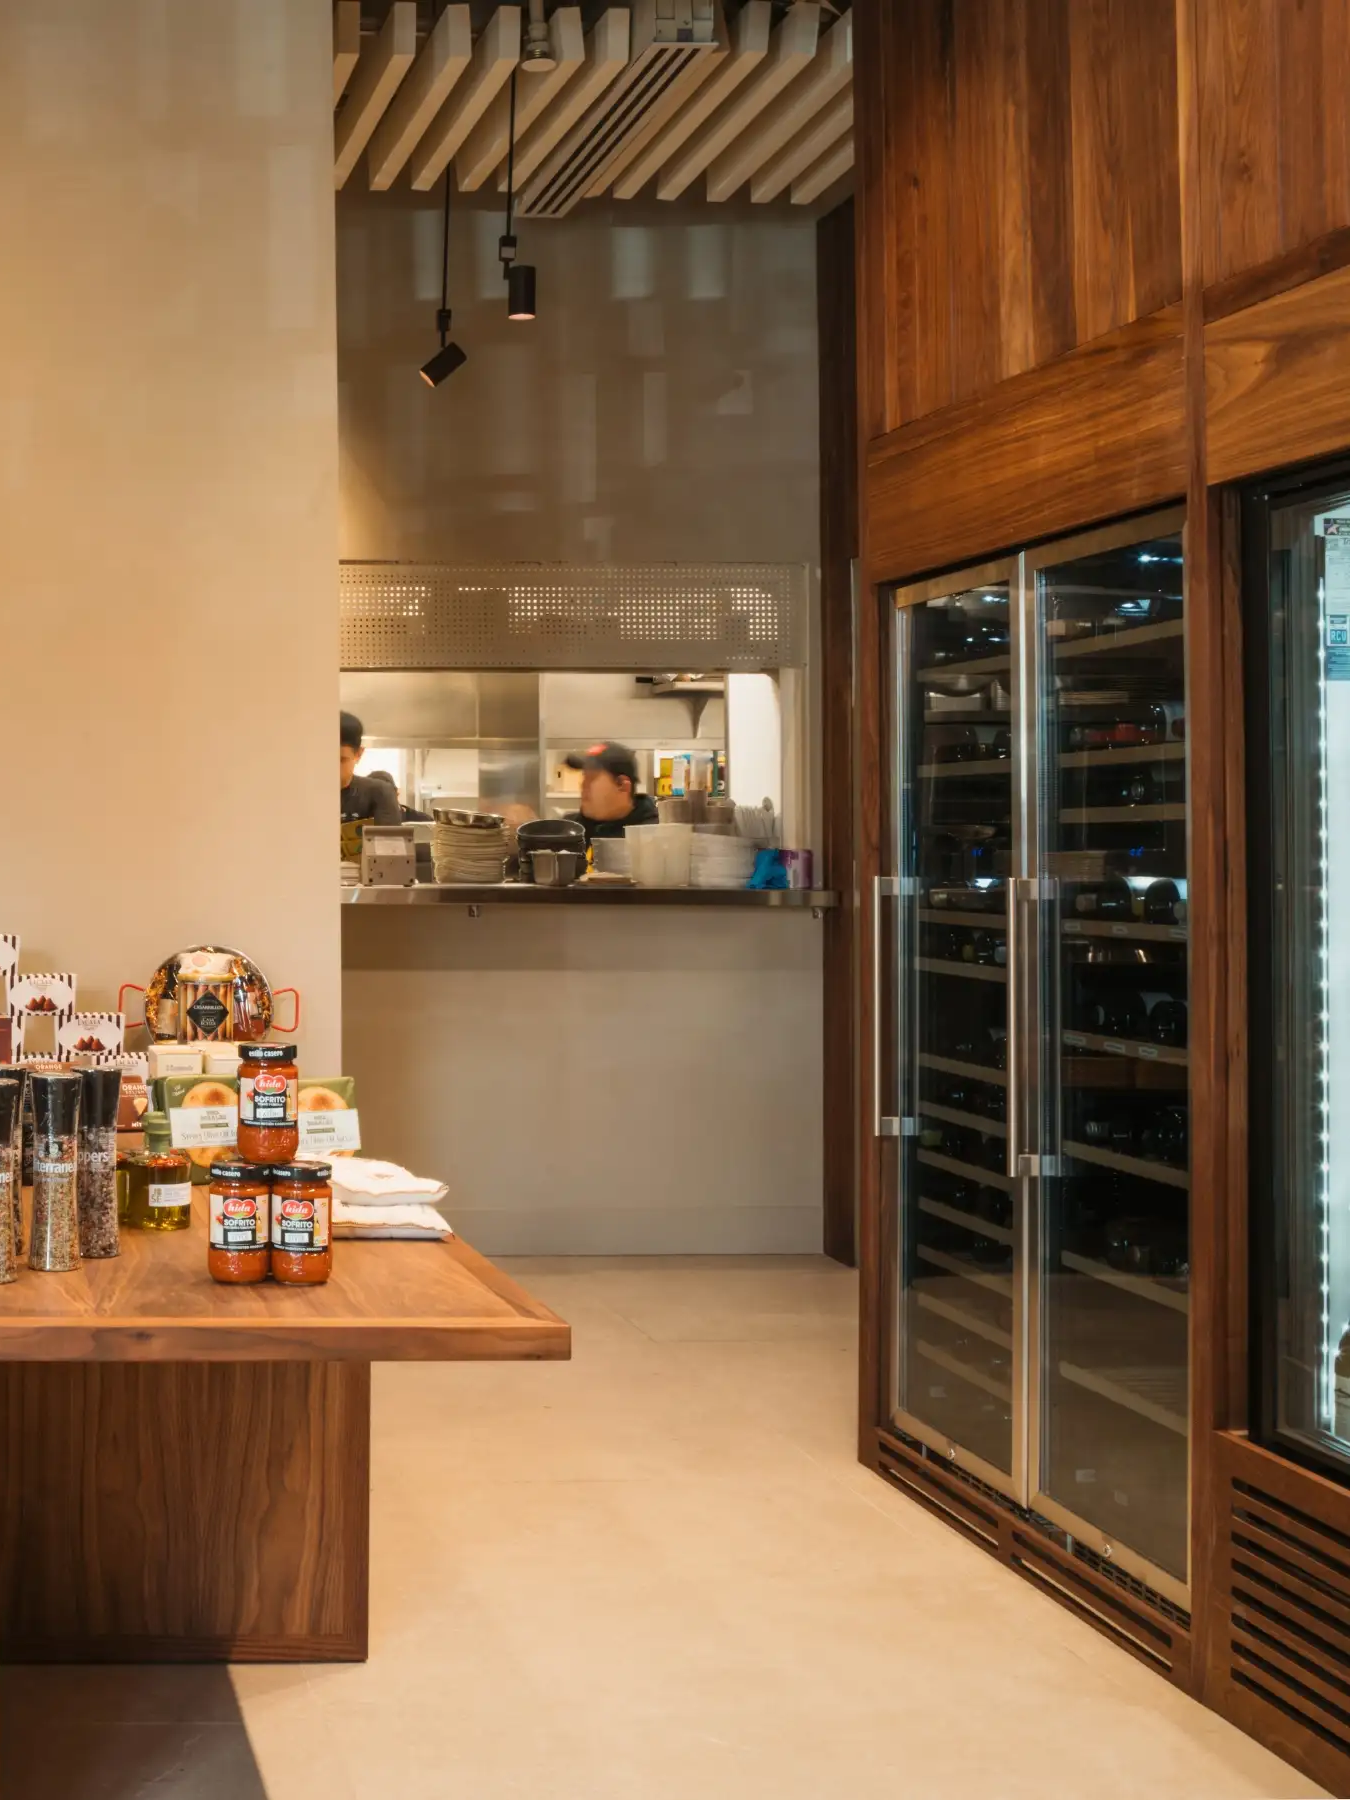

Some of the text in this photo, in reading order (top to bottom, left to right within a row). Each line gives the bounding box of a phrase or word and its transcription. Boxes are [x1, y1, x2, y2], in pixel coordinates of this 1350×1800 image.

[258, 1080, 282, 1088] hida
[228, 1202, 252, 1212] hida
[285, 1204, 308, 1214] hida
[281, 1220, 313, 1228] SOFRITO
